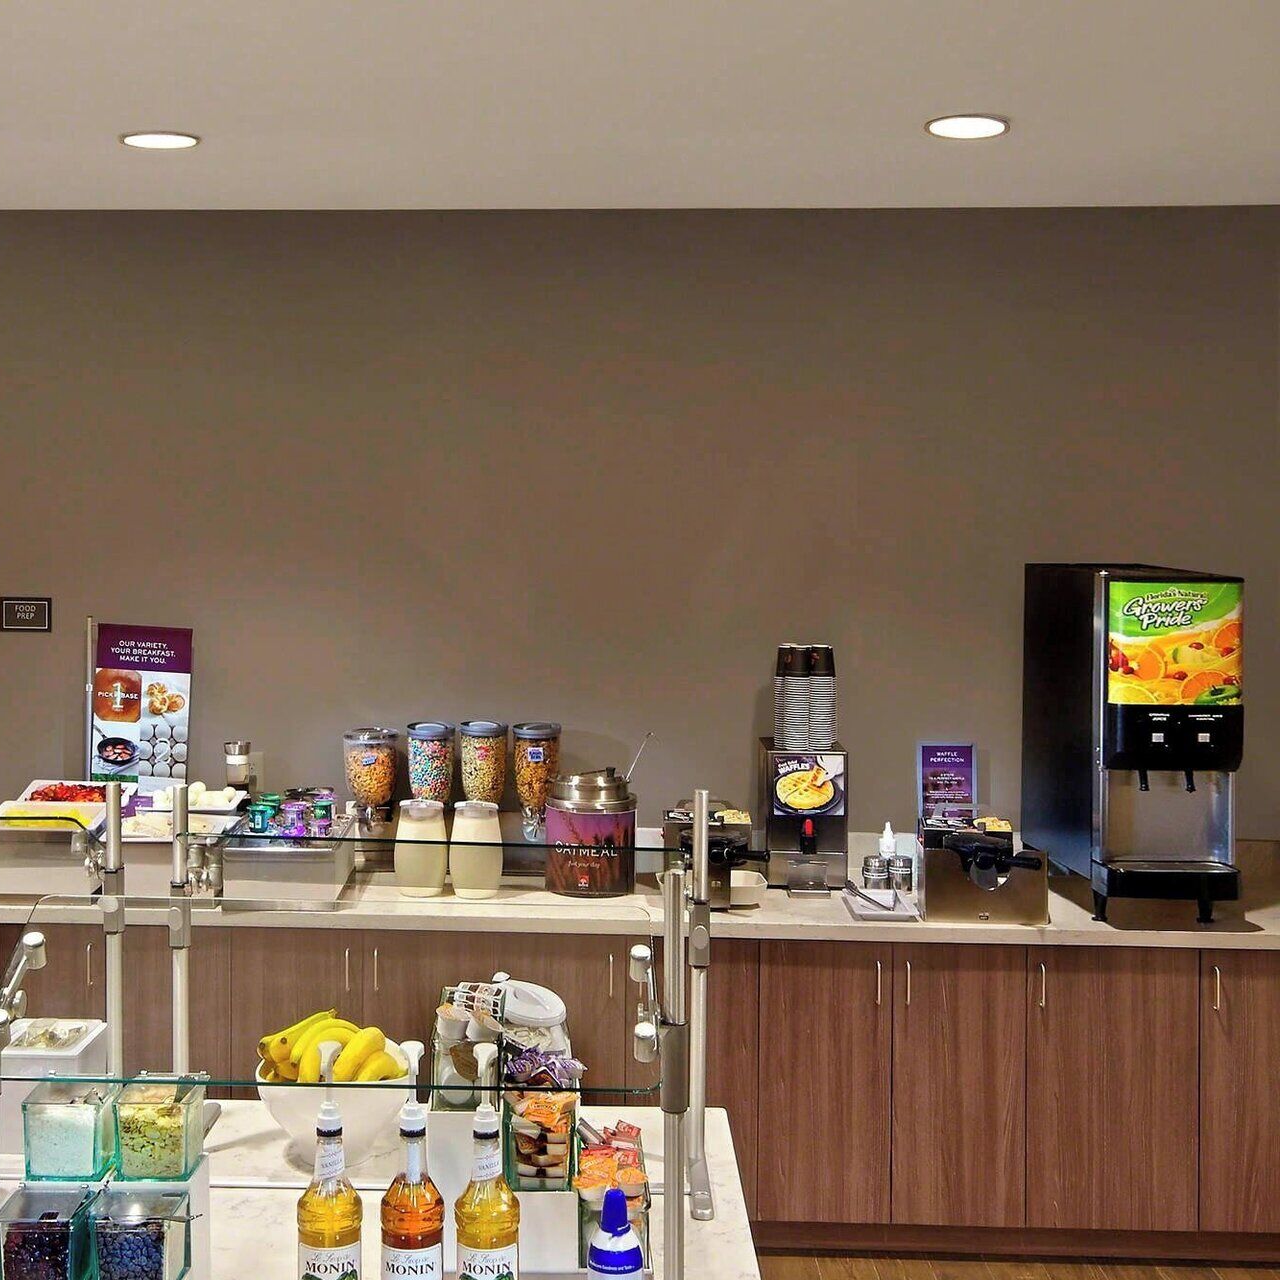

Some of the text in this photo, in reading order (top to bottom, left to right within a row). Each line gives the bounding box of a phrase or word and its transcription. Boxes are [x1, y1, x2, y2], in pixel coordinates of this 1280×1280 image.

[15, 604, 36, 612] FOOD
[16, 612, 35, 620] PREP
[1140, 611, 1192, 630] Pride
[110, 646, 131, 654] YOUR
[555, 840, 618, 857] OATMEAL
[305, 1259, 355, 1275] MONIN
[385, 1261, 435, 1276] MONIN
[462, 1260, 511, 1276] MONIN
